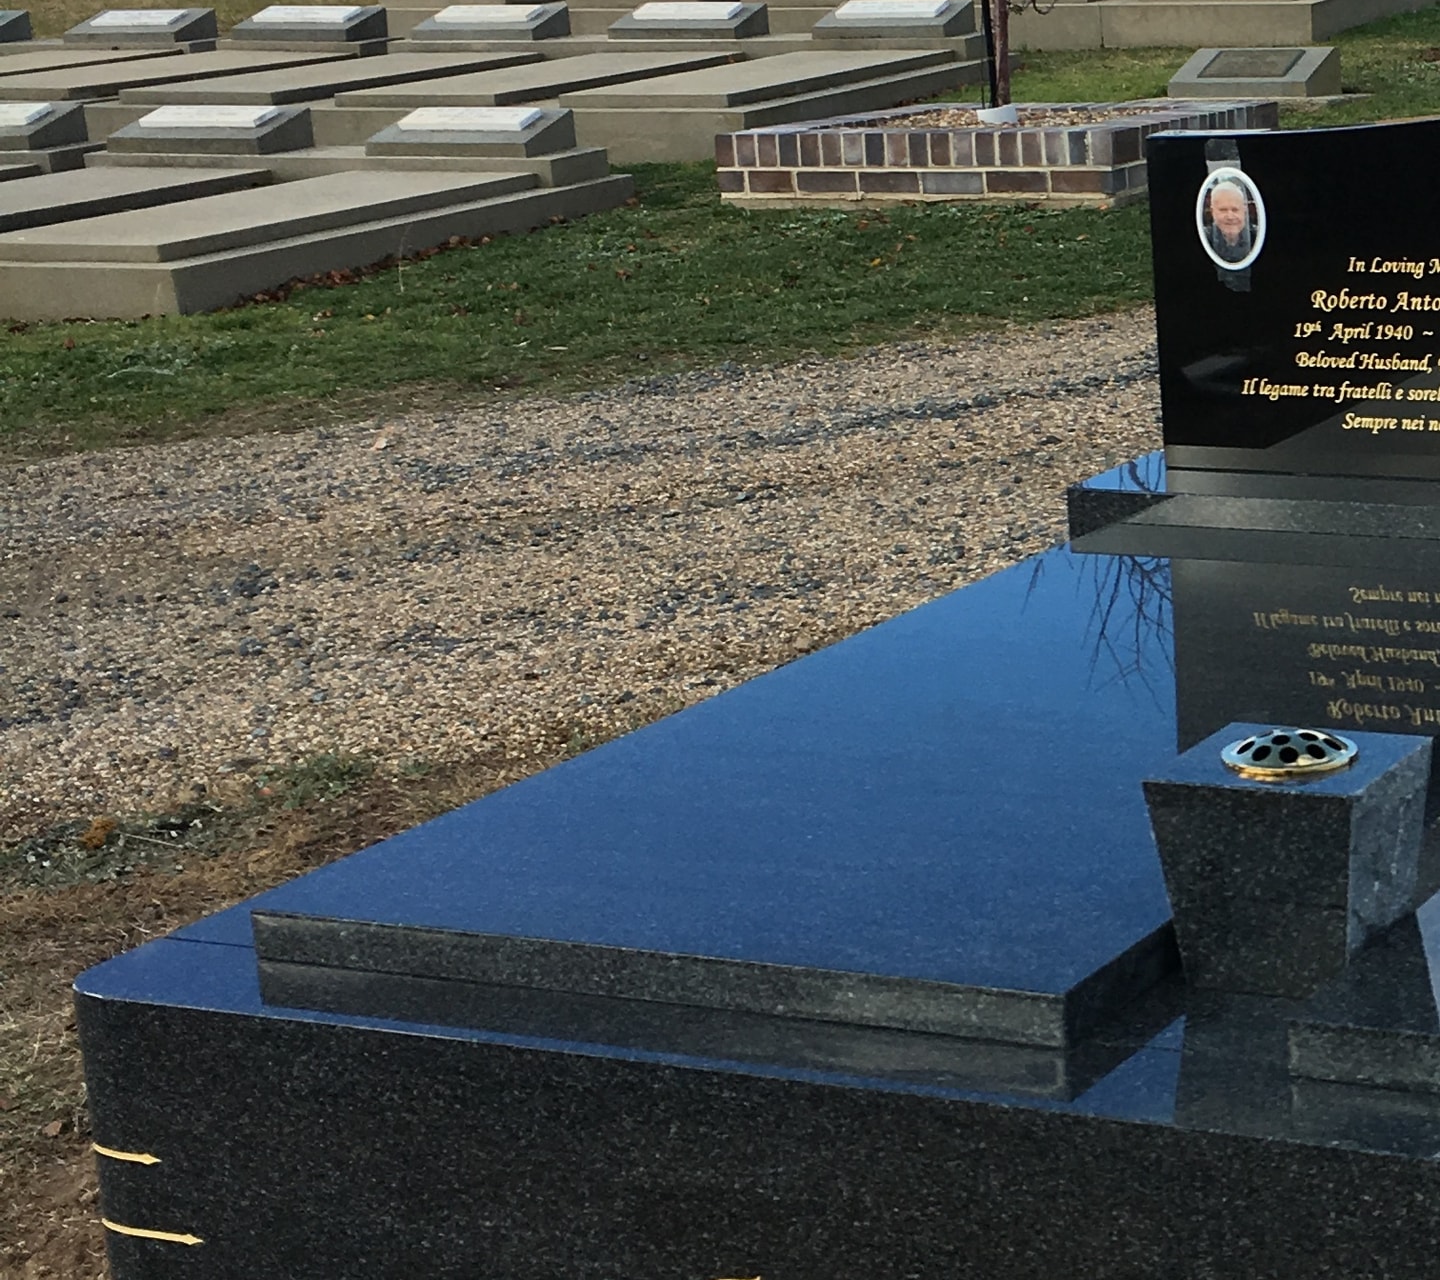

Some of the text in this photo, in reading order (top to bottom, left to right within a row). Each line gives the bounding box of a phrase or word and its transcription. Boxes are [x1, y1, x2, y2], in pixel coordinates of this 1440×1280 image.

[1347, 257, 1365, 272] In
[1369, 257, 1425, 279] Loving
[1311, 288, 1387, 312] Roberto
[1294, 321, 1321, 337] 19th
[1328, 322, 1374, 344] April
[1375, 325, 1413, 340] 1940
[1295, 350, 1359, 368] Beloved
[1359, 352, 1432, 374] Husband,
[1242, 378, 1258, 395] Il
[1259, 379, 1309, 401] legame
[1313, 384, 1335, 398] tra
[1335, 381, 1392, 403] fratelli
[1395, 388, 1404, 400] e
[1342, 413, 1397, 434] Sempre
[1401, 415, 1425, 431] nei
